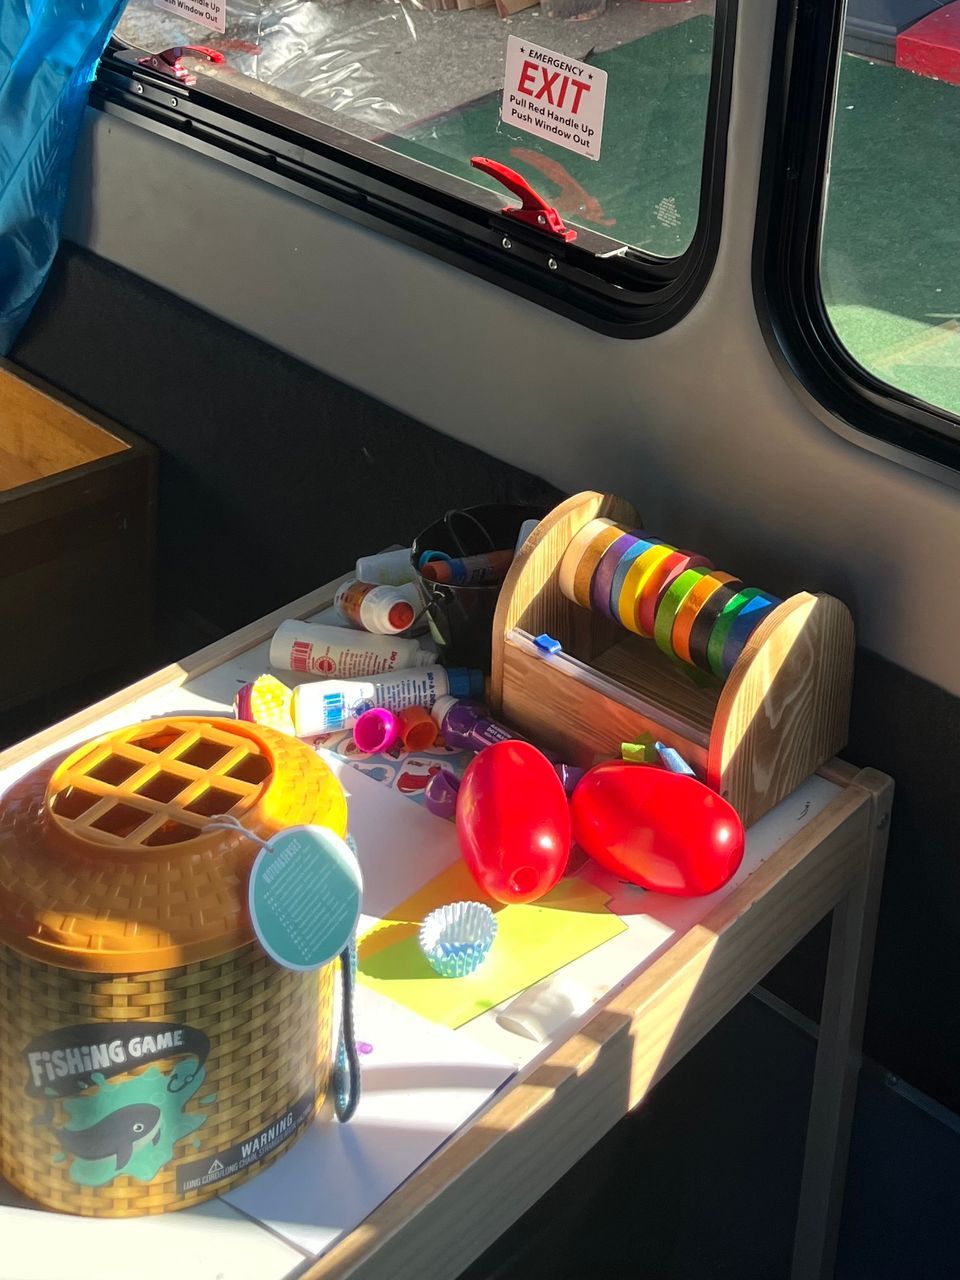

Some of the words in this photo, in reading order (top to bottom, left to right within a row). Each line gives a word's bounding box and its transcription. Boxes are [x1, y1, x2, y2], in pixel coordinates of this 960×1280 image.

[178, 1, 204, 17] Window
[206, 12, 218, 23] Out
[210, 4, 220, 13] Up
[528, 49, 584, 76] EMERGENCY
[517, 60, 591, 114] EXIT
[510, 94, 526, 108] Pull
[528, 102, 545, 115] Red
[548, 110, 579, 130] Handle
[582, 124, 594, 136] Up
[512, 108, 532, 124] Push
[535, 118, 572, 140] Window
[573, 134, 590, 148] Out
[128, 1030, 184, 1058] GAME
[241, 1112, 293, 1158] WARNING
